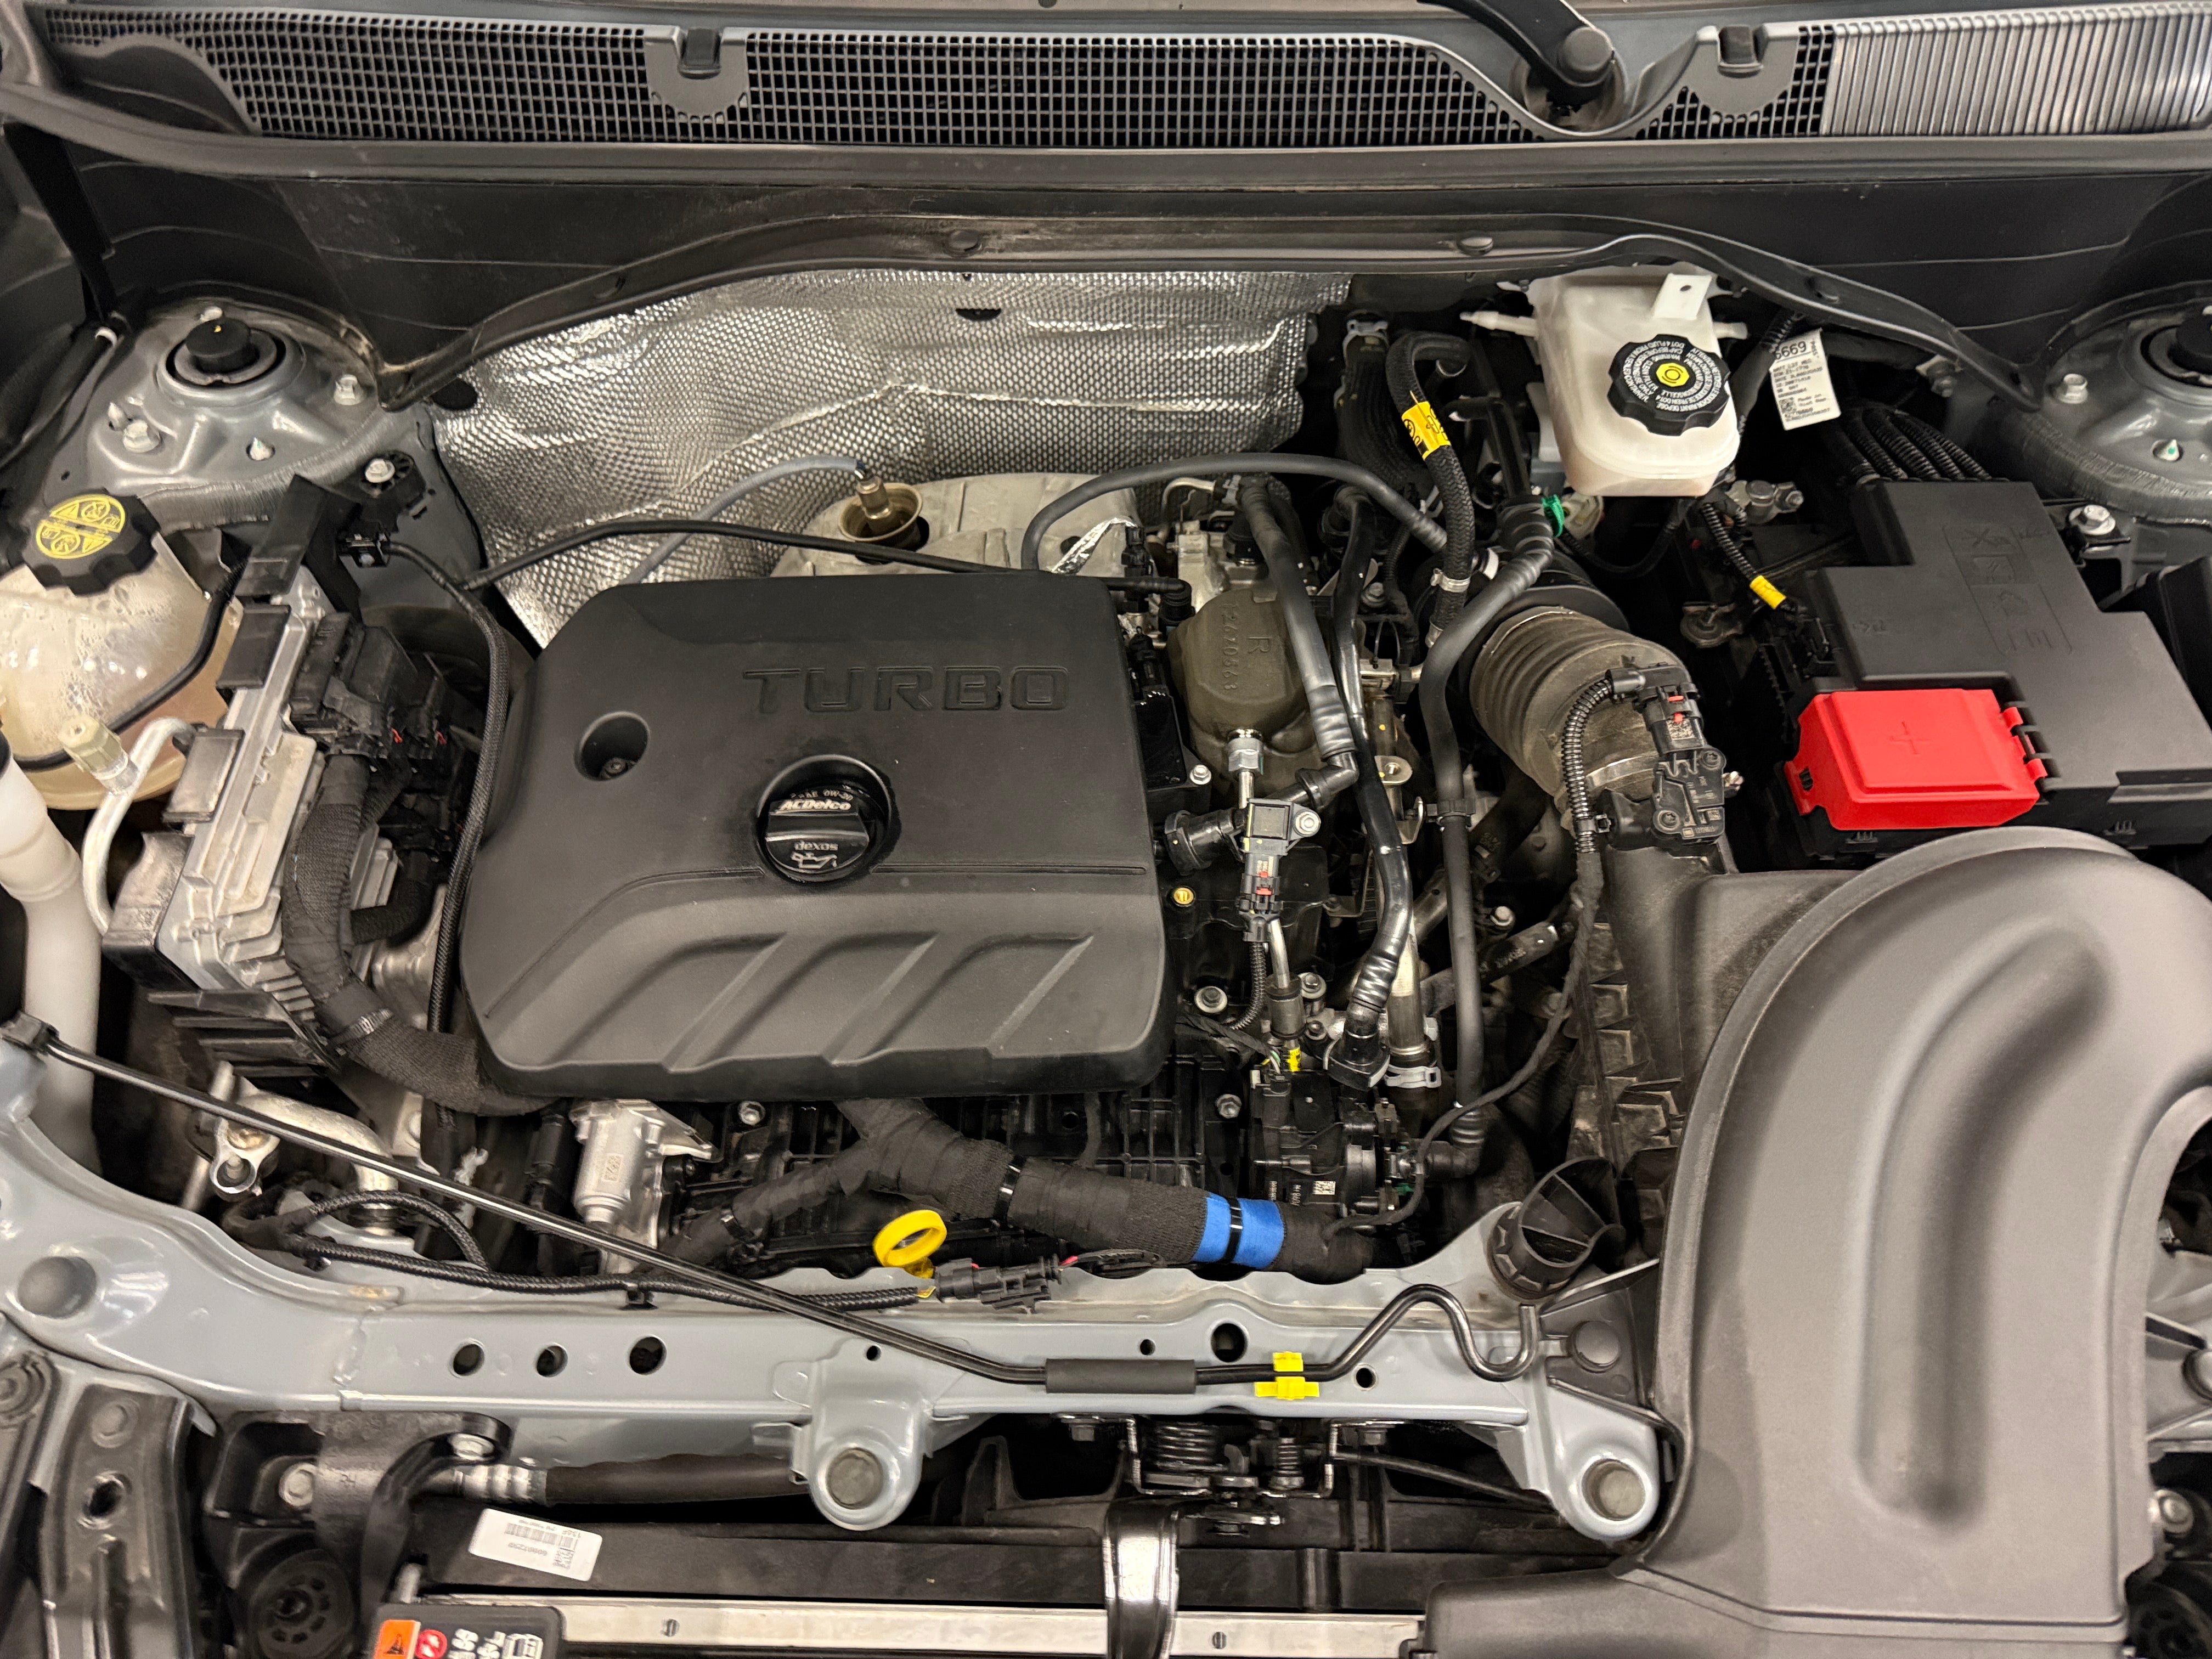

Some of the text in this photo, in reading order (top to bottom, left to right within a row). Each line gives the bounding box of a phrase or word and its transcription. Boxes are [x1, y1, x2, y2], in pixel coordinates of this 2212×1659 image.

[1631, 343, 1649, 356] FROM
[1645, 340, 1666, 348] FLUID
[1671, 341, 1685, 349] DOT
[1650, 353, 1681, 362] WARNING
[1689, 347, 1717, 368] ATTENTION
[1623, 356, 1635, 375] SEALED
[1633, 376, 1643, 385] USE
[1641, 375, 1658, 391] FILLER
[1637, 383, 1654, 397] ONLY
[1248, 636, 1272, 654] R
[743, 666, 1068, 713] TURBO
[823, 789, 854, 801] 0W-20
[779, 799, 851, 810] ACDelco
[794, 840, 839, 851] dexos
